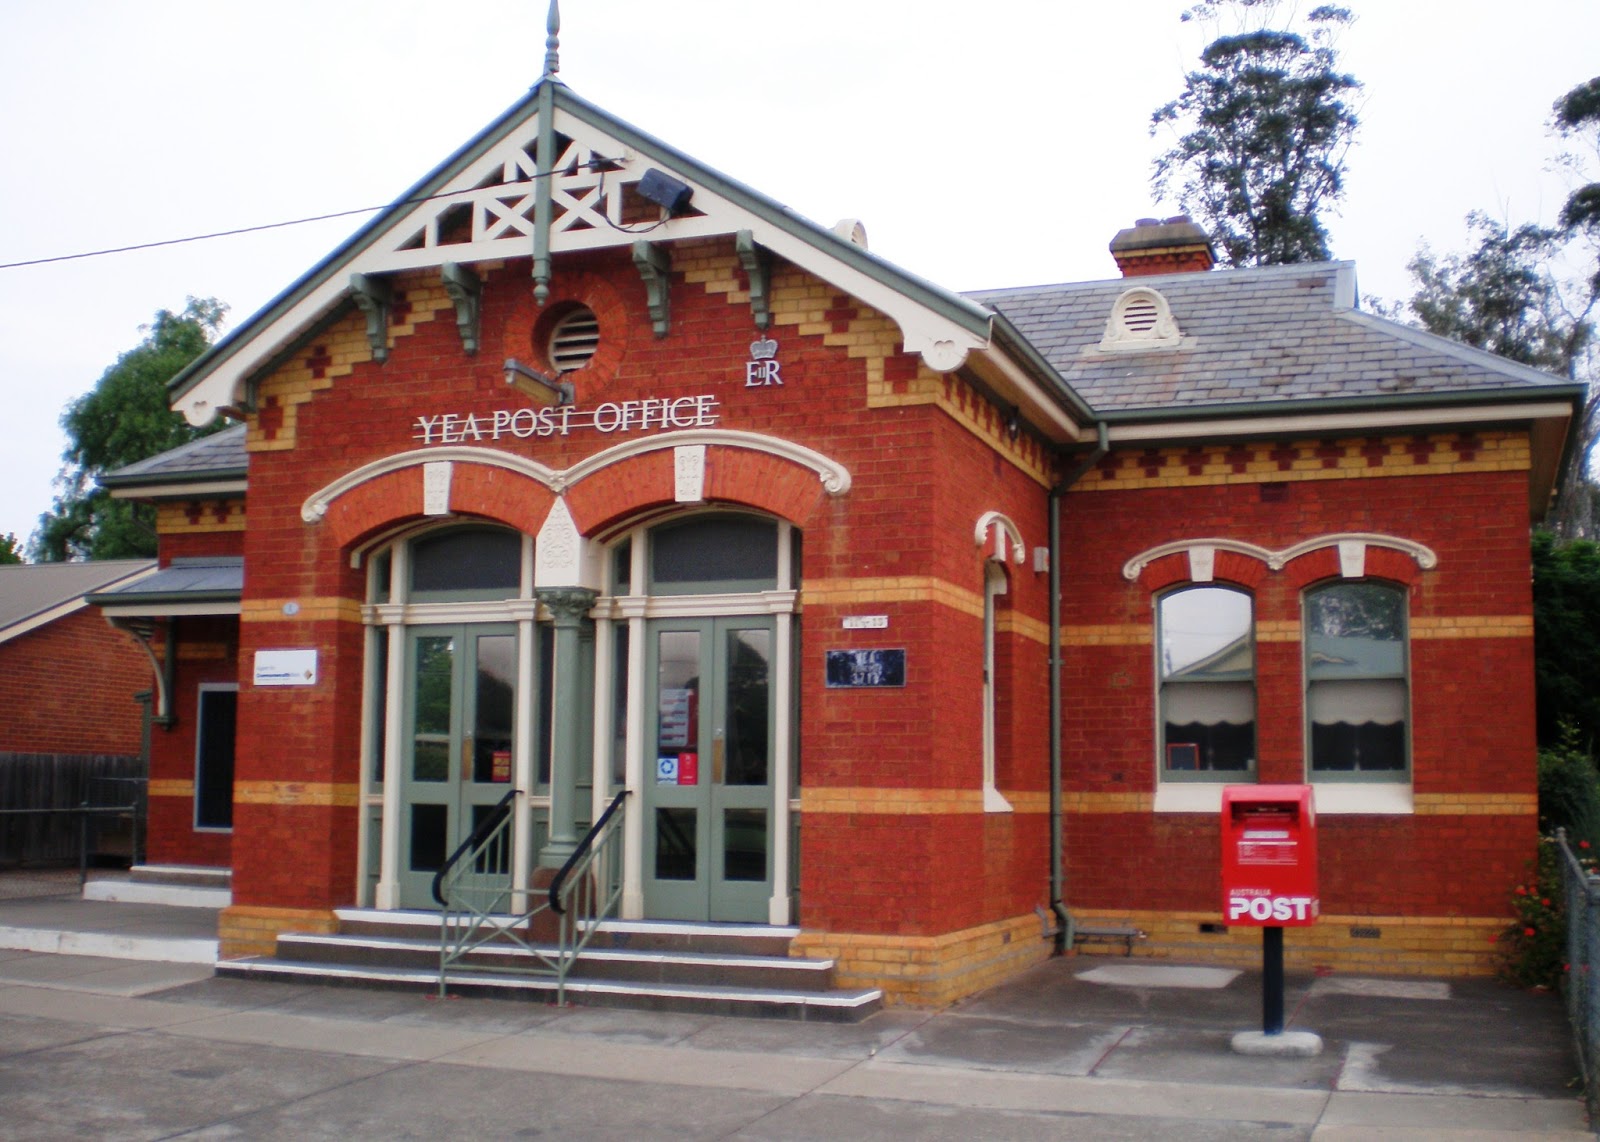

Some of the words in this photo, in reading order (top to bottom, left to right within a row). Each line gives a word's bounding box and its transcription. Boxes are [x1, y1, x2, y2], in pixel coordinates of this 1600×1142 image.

[418, 413, 482, 444] YEA
[492, 405, 576, 440] POST
[593, 395, 716, 433] OFFICE
[1229, 888, 1272, 896] AUSTRALIA
[1229, 897, 1312, 921] POST
